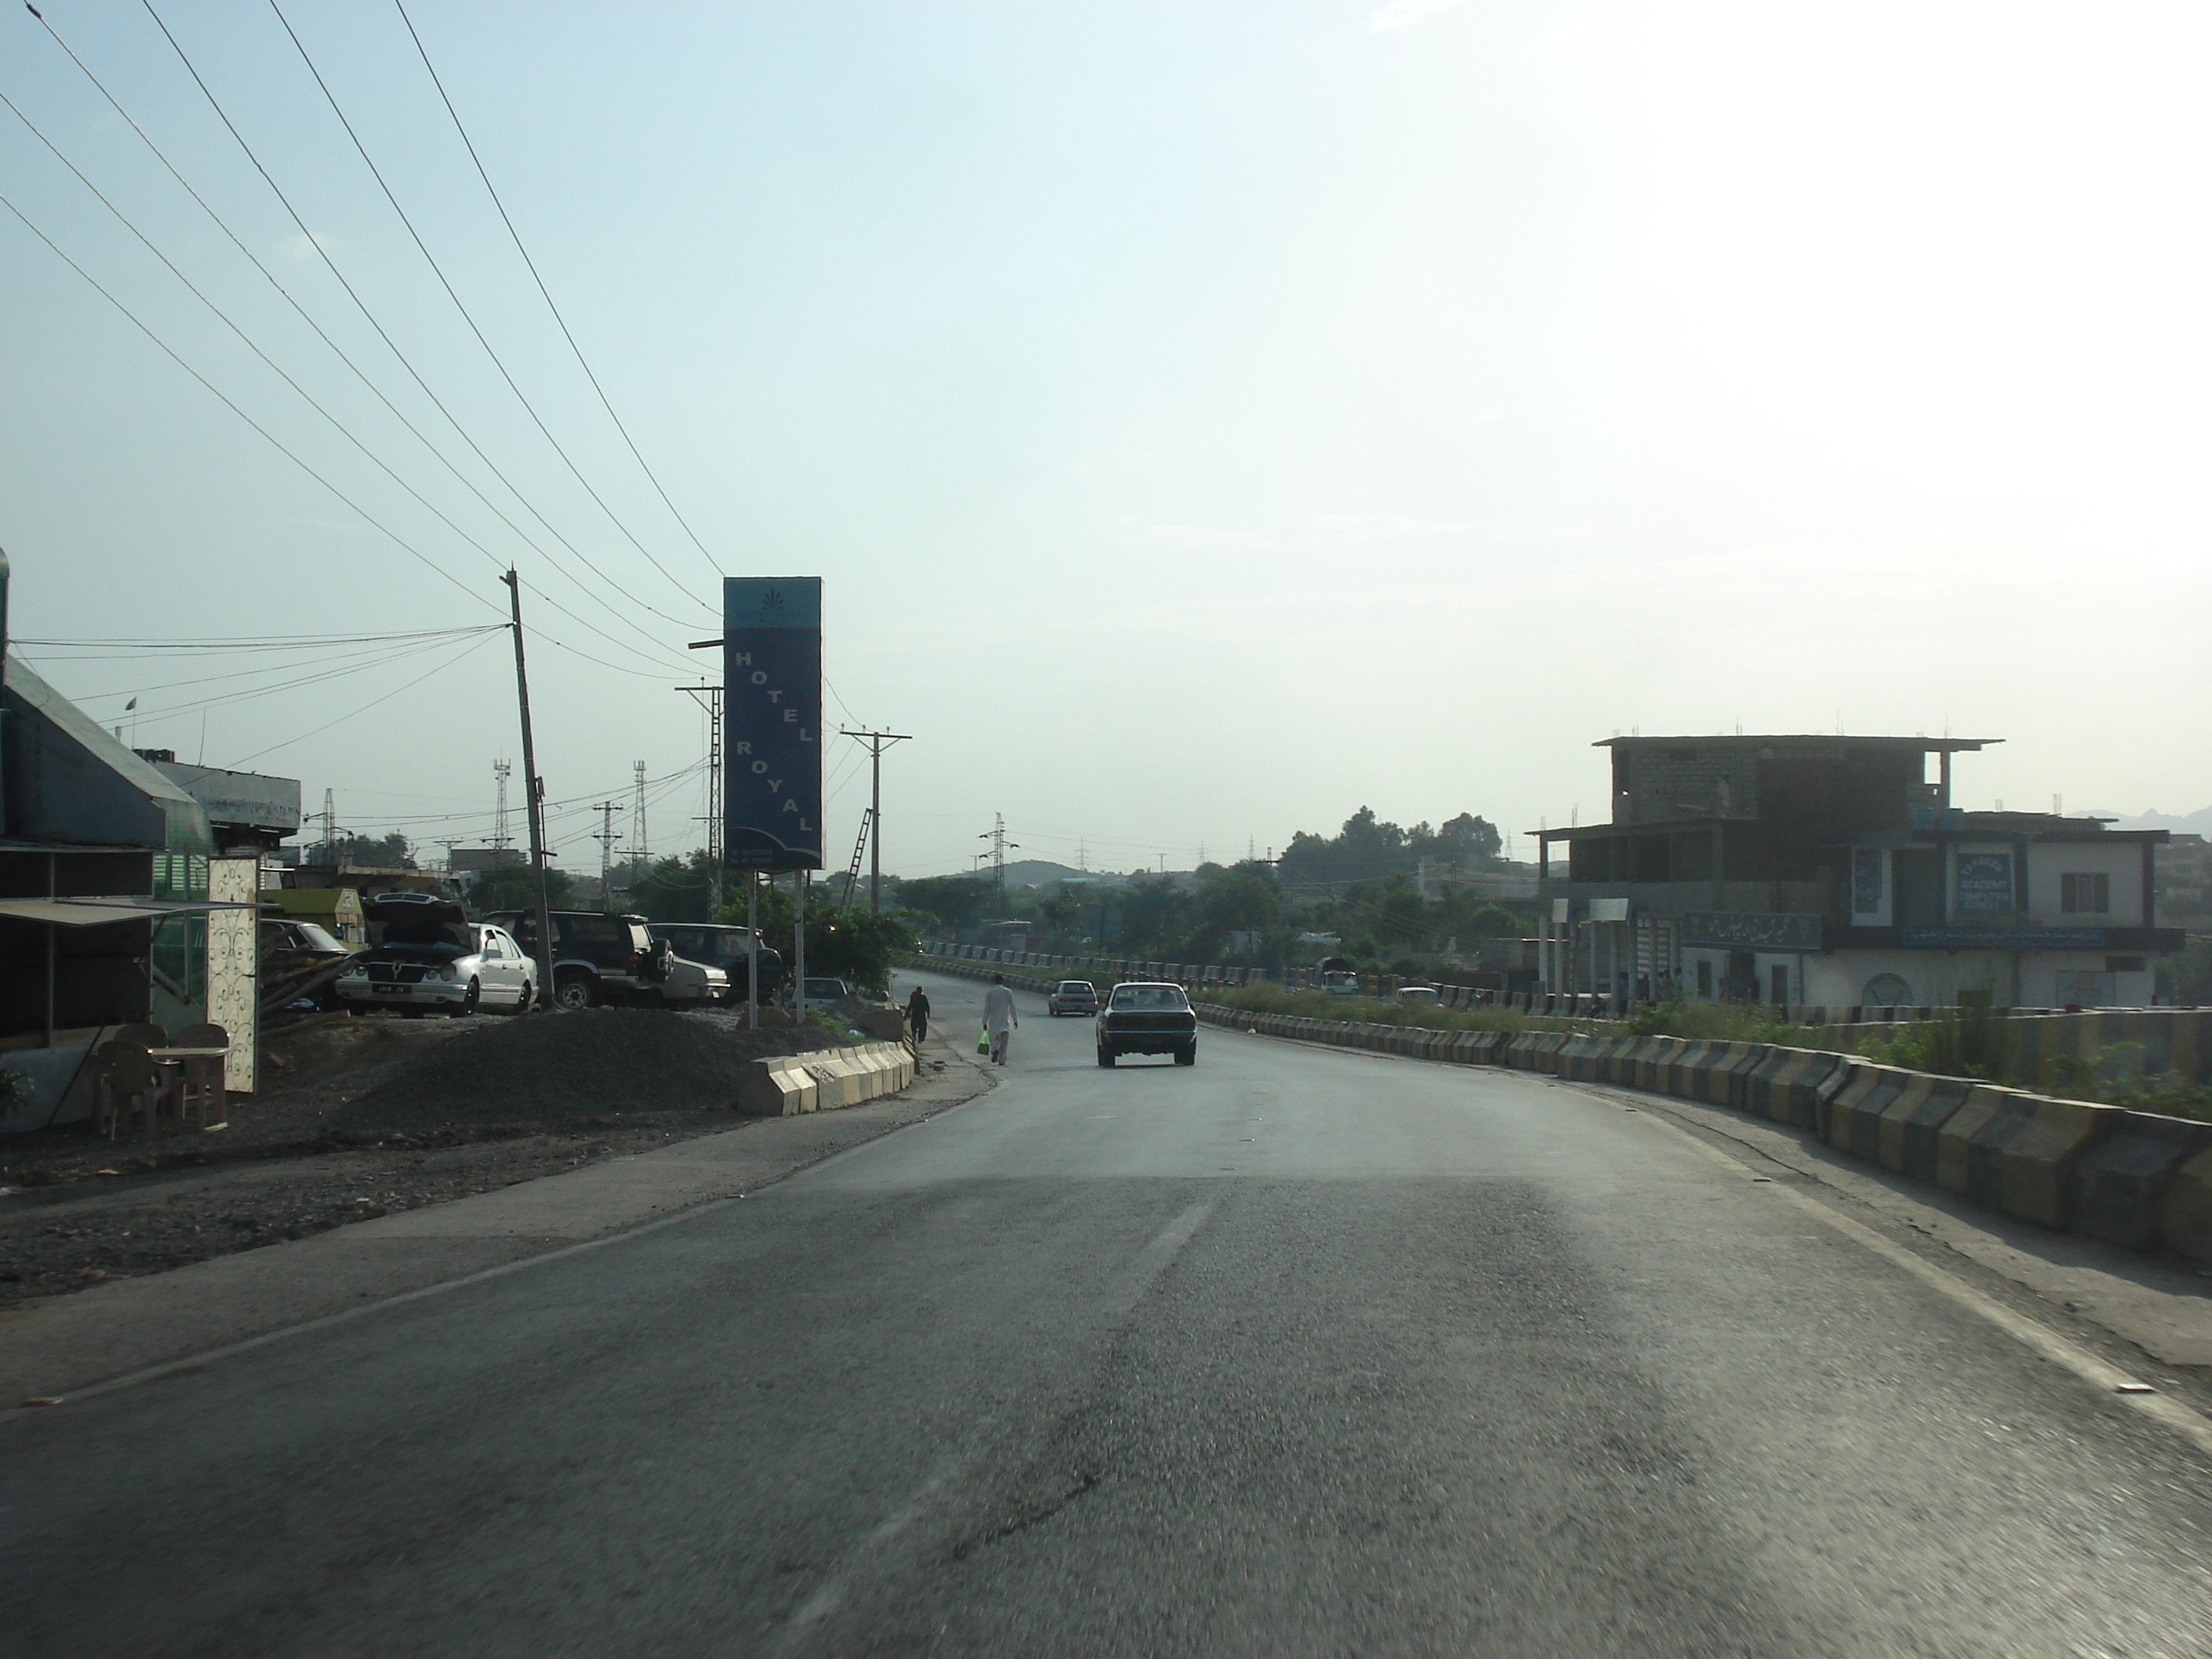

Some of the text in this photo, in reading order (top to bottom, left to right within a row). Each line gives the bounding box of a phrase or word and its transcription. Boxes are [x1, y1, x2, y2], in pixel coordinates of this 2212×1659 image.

[736, 652, 812, 742] HOTEL
[737, 741, 812, 831] ROYAL
[1961, 880, 2007, 888] ACADEMY
